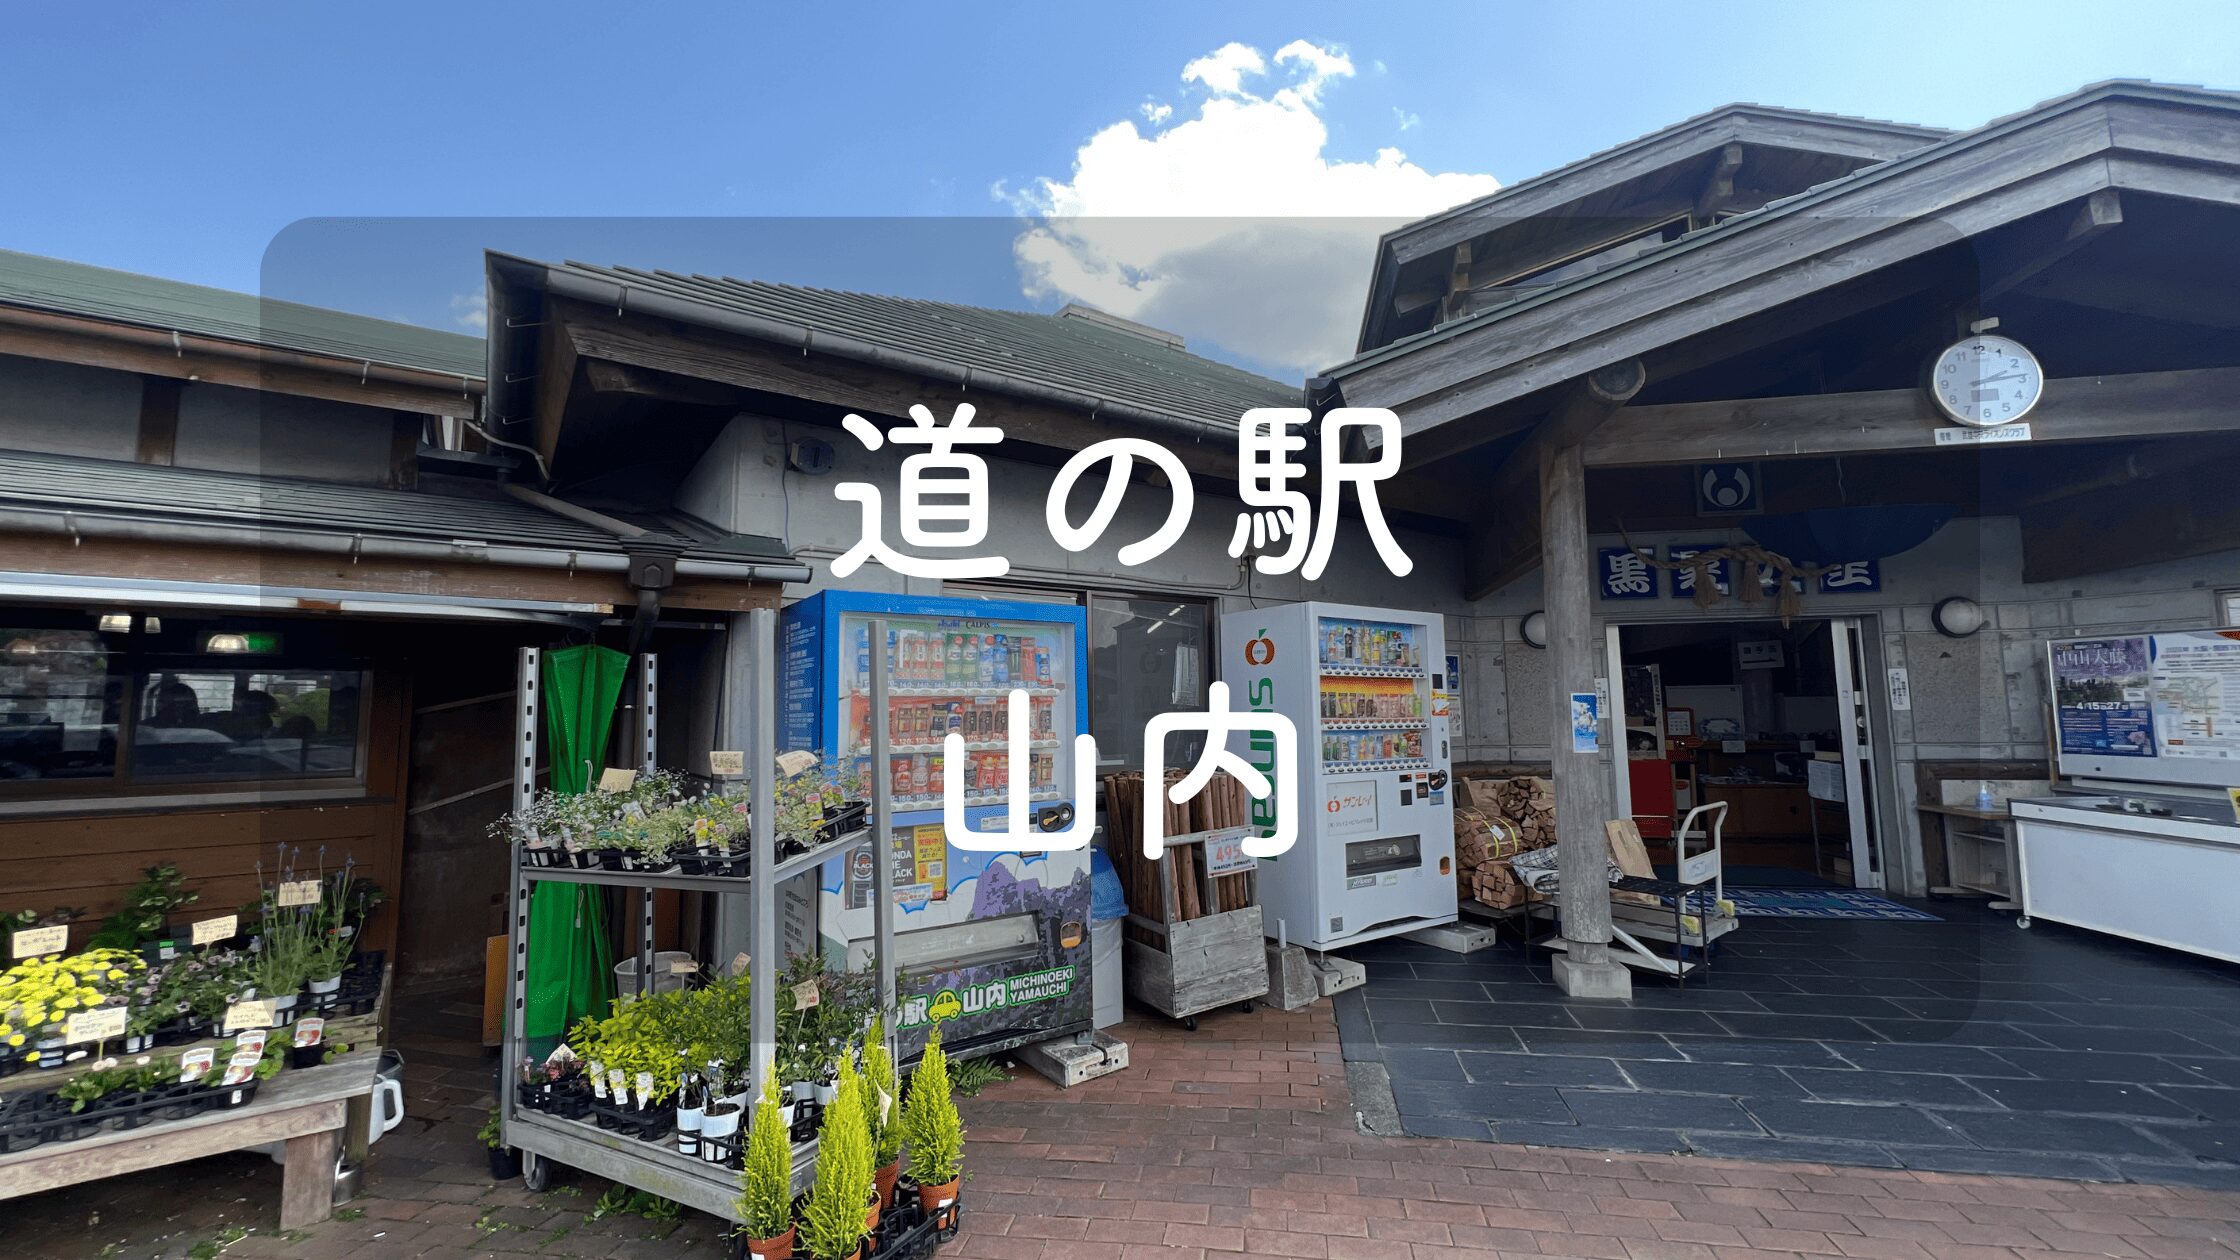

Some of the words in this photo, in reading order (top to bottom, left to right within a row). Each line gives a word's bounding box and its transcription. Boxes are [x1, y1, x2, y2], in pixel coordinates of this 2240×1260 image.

[1972, 345, 1986, 355] 12
[1995, 347, 2003, 357] 1
[1956, 351, 1967, 361] 11
[2010, 358, 2019, 368] 2
[1943, 363, 1957, 374] 10
[1941, 379, 1949, 389] 9
[2018, 375, 2026, 384] 3
[2014, 390, 2024, 399] 4
[1950, 395, 1957, 405] 8
[1963, 405, 1972, 415] 7
[2002, 403, 2011, 412] 5
[1983, 408, 1991, 418] 6
[891, 850, 912, 860] NDA
[892, 868, 912, 878] ACK
[1010, 967, 1073, 991] MICHINOEKI
[962, 982, 1006, 1013] 山内
[1009, 981, 1067, 1004] YAMAUCHI
